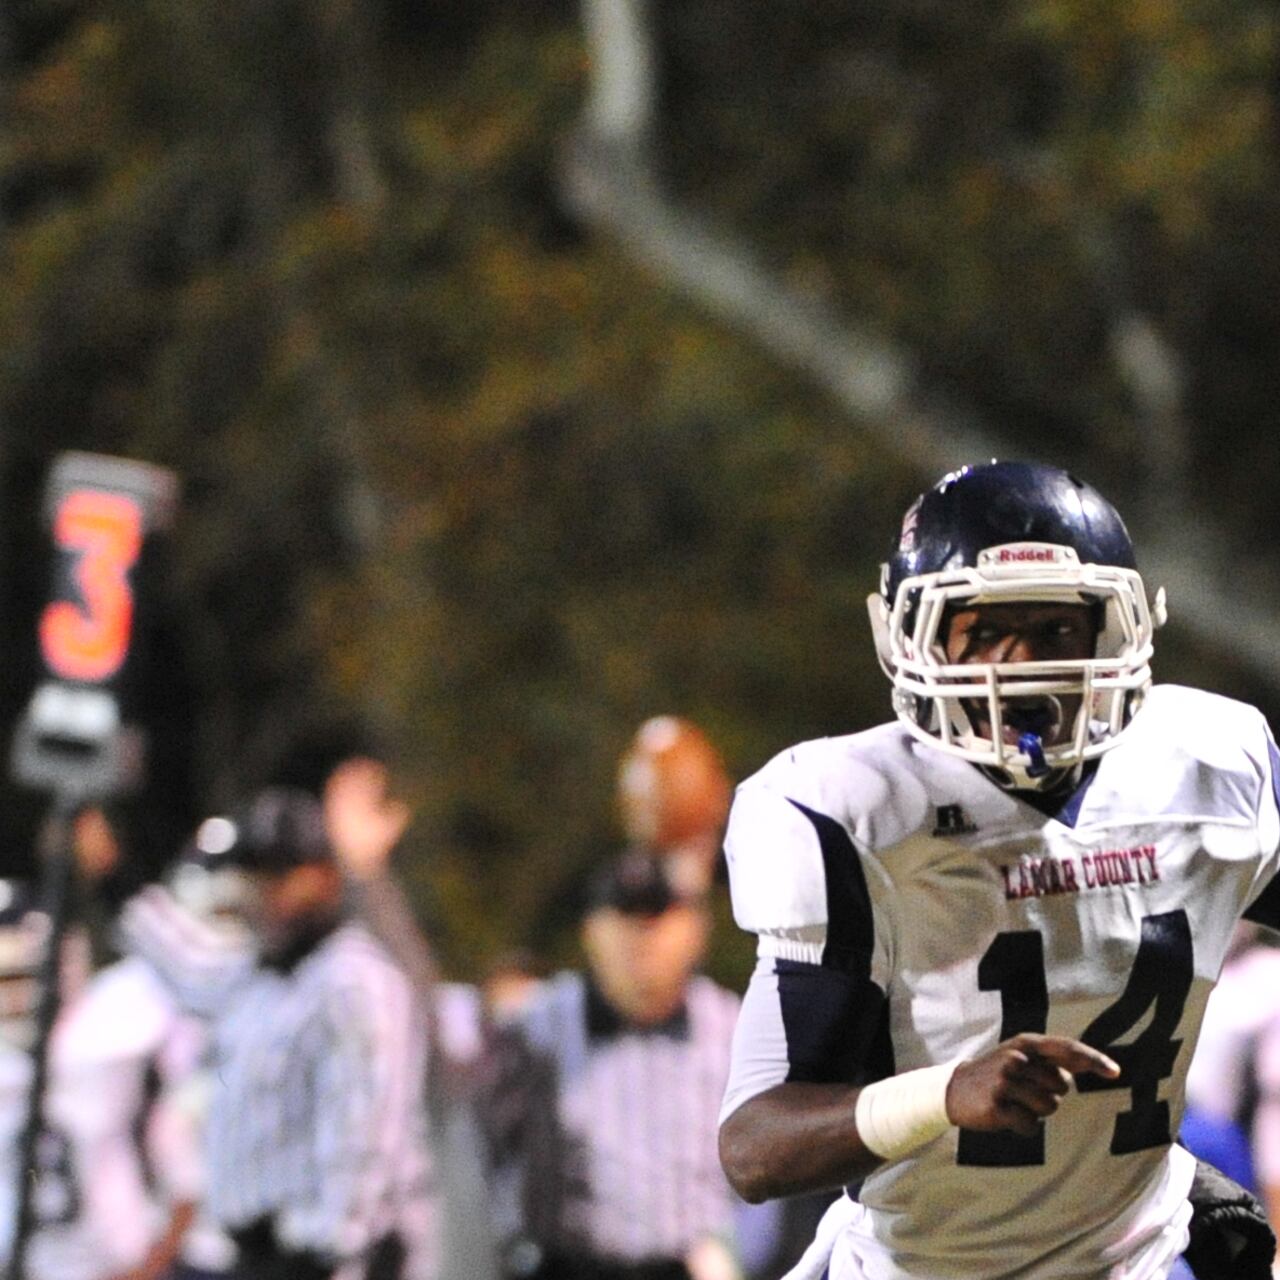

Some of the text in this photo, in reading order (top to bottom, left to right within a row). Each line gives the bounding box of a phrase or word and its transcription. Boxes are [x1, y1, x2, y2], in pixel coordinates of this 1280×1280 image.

[39, 491, 142, 682] 3
[1000, 548, 1054, 562] Riddell
[1001, 843, 1160, 900] LAMAR COUNTY
[956, 908, 1195, 1168] 14
